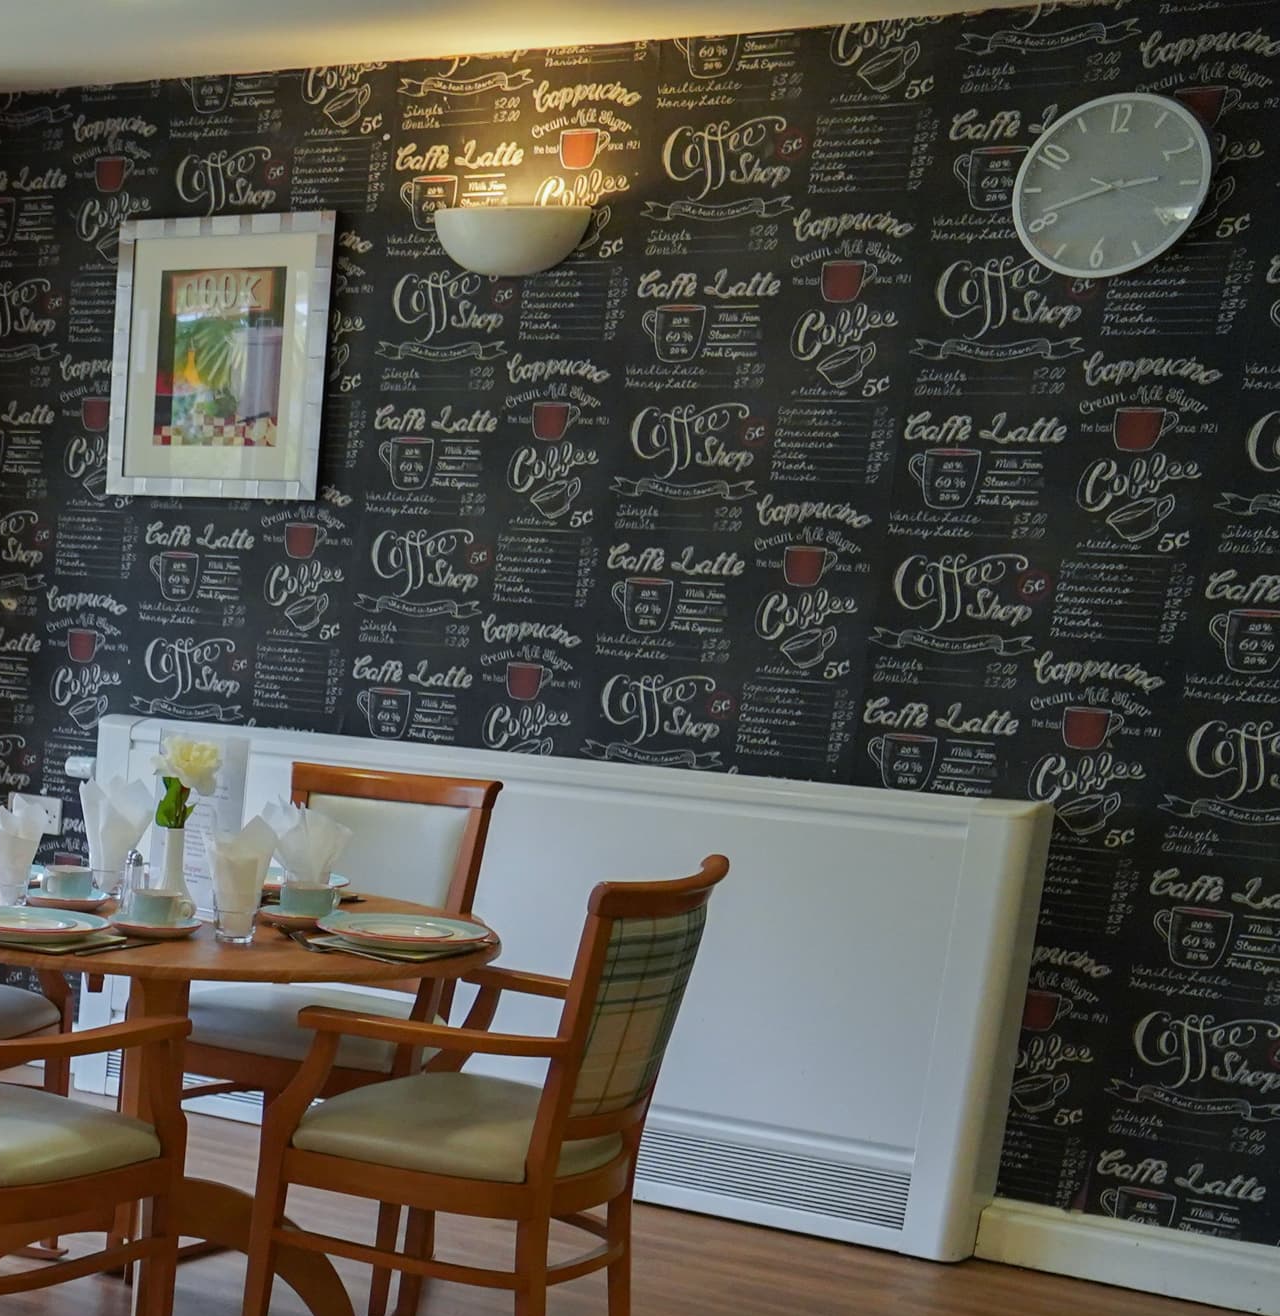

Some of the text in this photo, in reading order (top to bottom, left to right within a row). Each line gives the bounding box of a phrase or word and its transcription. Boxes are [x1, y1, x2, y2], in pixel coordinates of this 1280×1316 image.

[531, 117, 569, 138] Cream
[599, 110, 632, 132] Sugar
[1110, 103, 1133, 133] 12
[454, 140, 524, 169] Latte
[663, 116, 791, 200] Coffee Shop
[1038, 143, 1070, 171] 10
[175, 146, 277, 214] Coffee Shop
[1028, 211, 1058, 233] 8
[791, 248, 831, 268] Cream
[865, 241, 903, 264] Sugar
[1089, 237, 1105, 268] 6
[178, 272, 262, 313] COOK
[704, 268, 781, 299] Latte
[936, 256, 1082, 339] Coffee Shop
[13, 307, 57, 336] Shop
[393, 271, 504, 343] Coffee Shop
[791, 303, 899, 361] Coffee
[431, 405, 497, 434] Latte
[1079, 392, 1125, 414] Cream
[1165, 389, 1208, 414] Sugar
[630, 402, 754, 479] Coffee Shop
[979, 411, 1068, 444] Latte
[506, 441, 600, 493] Coffee
[1076, 453, 1202, 512] Coffee
[2, 537, 43, 566] Shop
[196, 523, 255, 550] Latte
[370, 527, 479, 598] Coffee Shop
[670, 545, 745, 578] Latte
[264, 560, 344, 607] Coffee
[893, 553, 1032, 632] Coffee Shop
[754, 588, 858, 640] Coffee
[50, 664, 122, 706] Coffee
[145, 637, 241, 700] Coffee Shop
[408, 655, 474, 690] Latte
[481, 702, 571, 750] Coffee
[600, 674, 721, 746] Coffee Shop
[935, 702, 1020, 736] Latte
[1028, 752, 1146, 801] Coffee
[1133, 1010, 1280, 1089] Coffee
[1174, 1162, 1266, 1202] Latte
